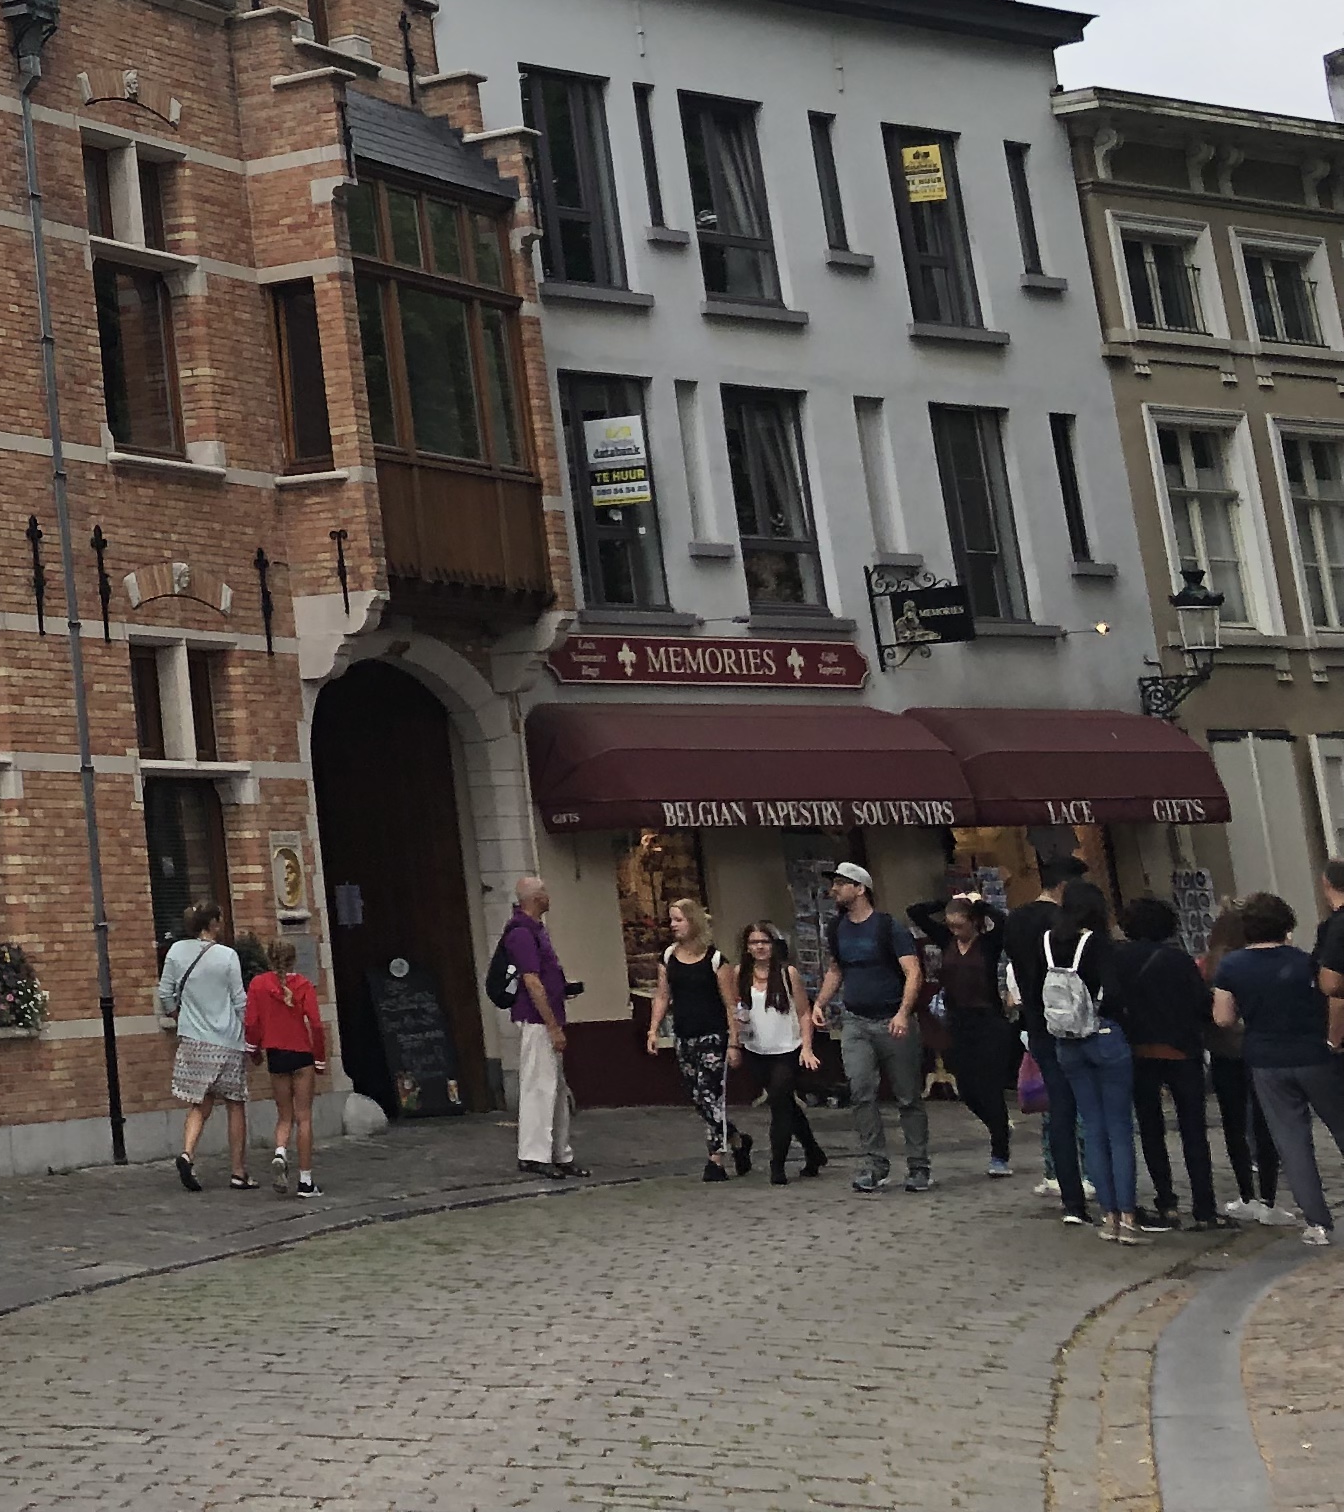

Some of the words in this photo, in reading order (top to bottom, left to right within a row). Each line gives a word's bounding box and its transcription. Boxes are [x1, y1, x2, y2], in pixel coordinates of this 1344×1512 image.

[595, 472, 609, 483] TE
[613, 469, 645, 482] HUUR
[919, 606, 965, 617] MEMORIES
[645, 646, 777, 676] MEMORIES
[552, 813, 580, 824] GIFTS
[662, 801, 747, 827] BELGIAN
[752, 801, 843, 826] TAPESTRY
[852, 800, 955, 826] SOUVENIRS
[1045, 800, 1095, 824] LACE
[1152, 799, 1206, 822] GIFTS
